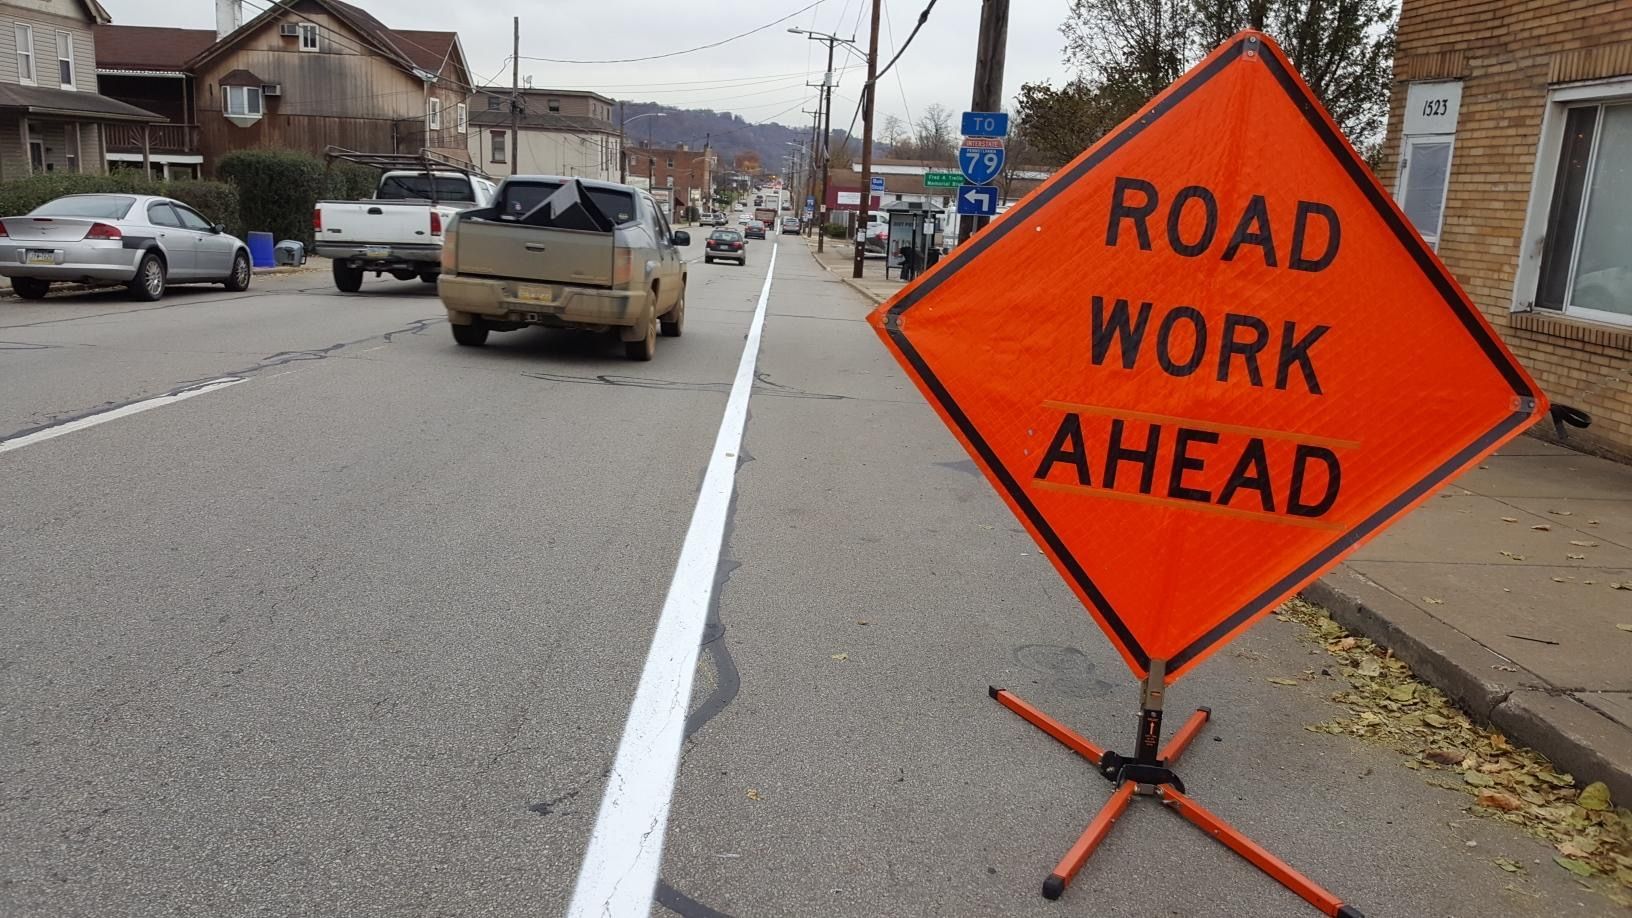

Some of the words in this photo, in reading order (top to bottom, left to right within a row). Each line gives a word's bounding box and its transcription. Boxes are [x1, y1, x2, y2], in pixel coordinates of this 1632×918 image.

[974, 117, 995, 131] TO
[1422, 98, 1449, 117] 1523
[966, 153, 998, 174] 79
[1105, 176, 1342, 273] ROAD
[1091, 295, 1332, 396] WORK
[1034, 413, 1342, 518] AHEAD
